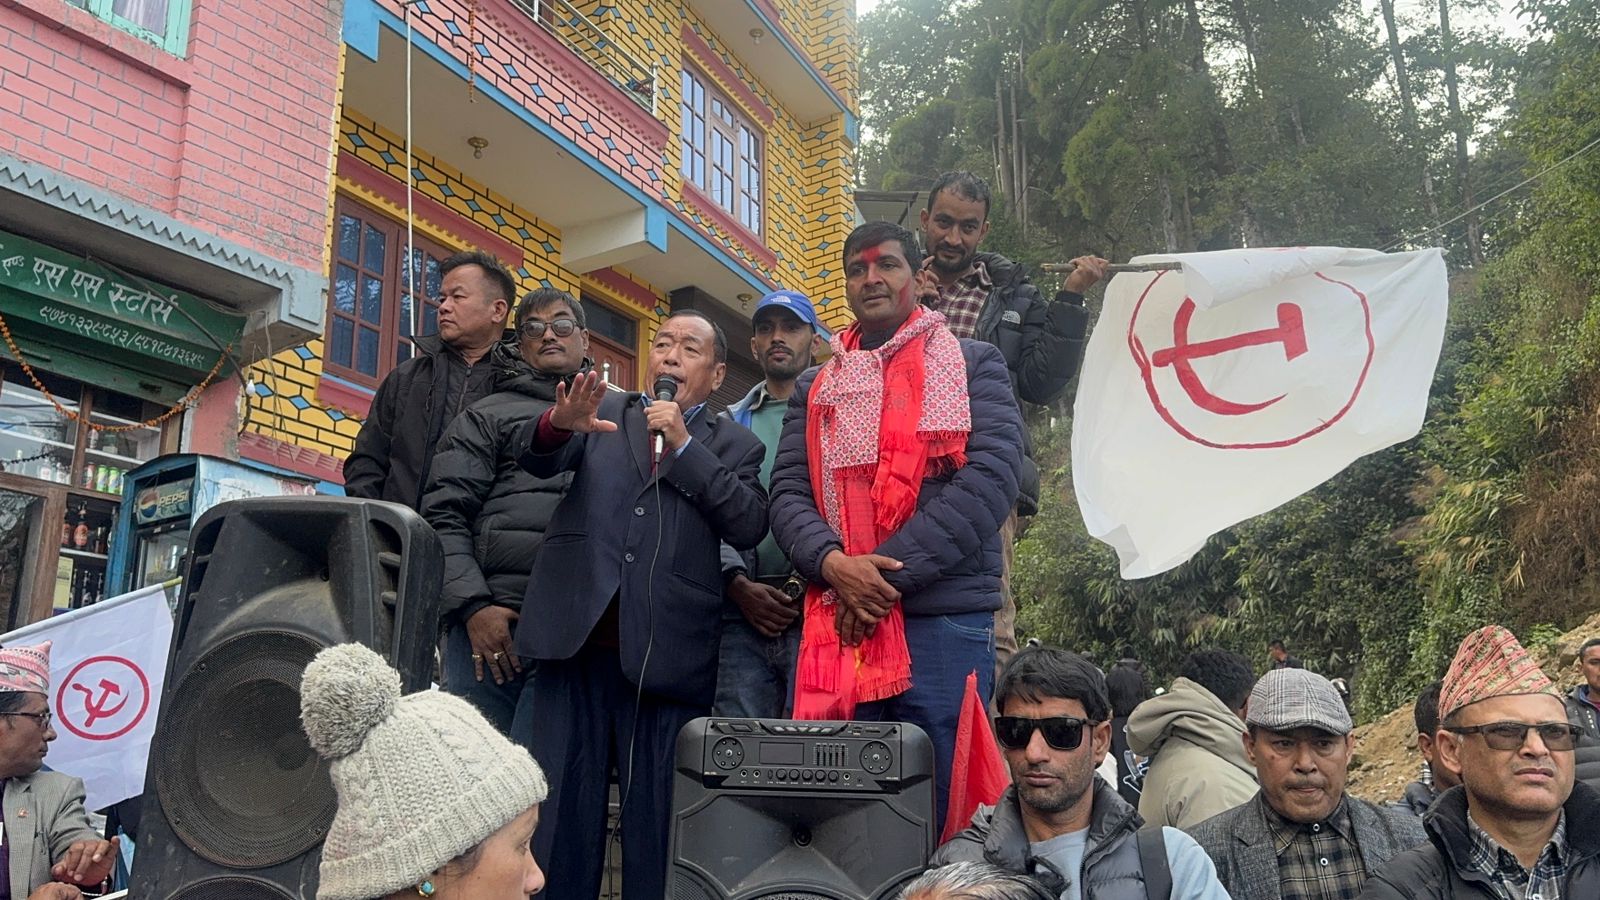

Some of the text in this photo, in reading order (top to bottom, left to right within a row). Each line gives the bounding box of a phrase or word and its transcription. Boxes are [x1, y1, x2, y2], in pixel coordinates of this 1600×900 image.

[33, 257, 69, 292] एस
[71, 270, 105, 303] एस
[160, 490, 189, 505] PEPSI
